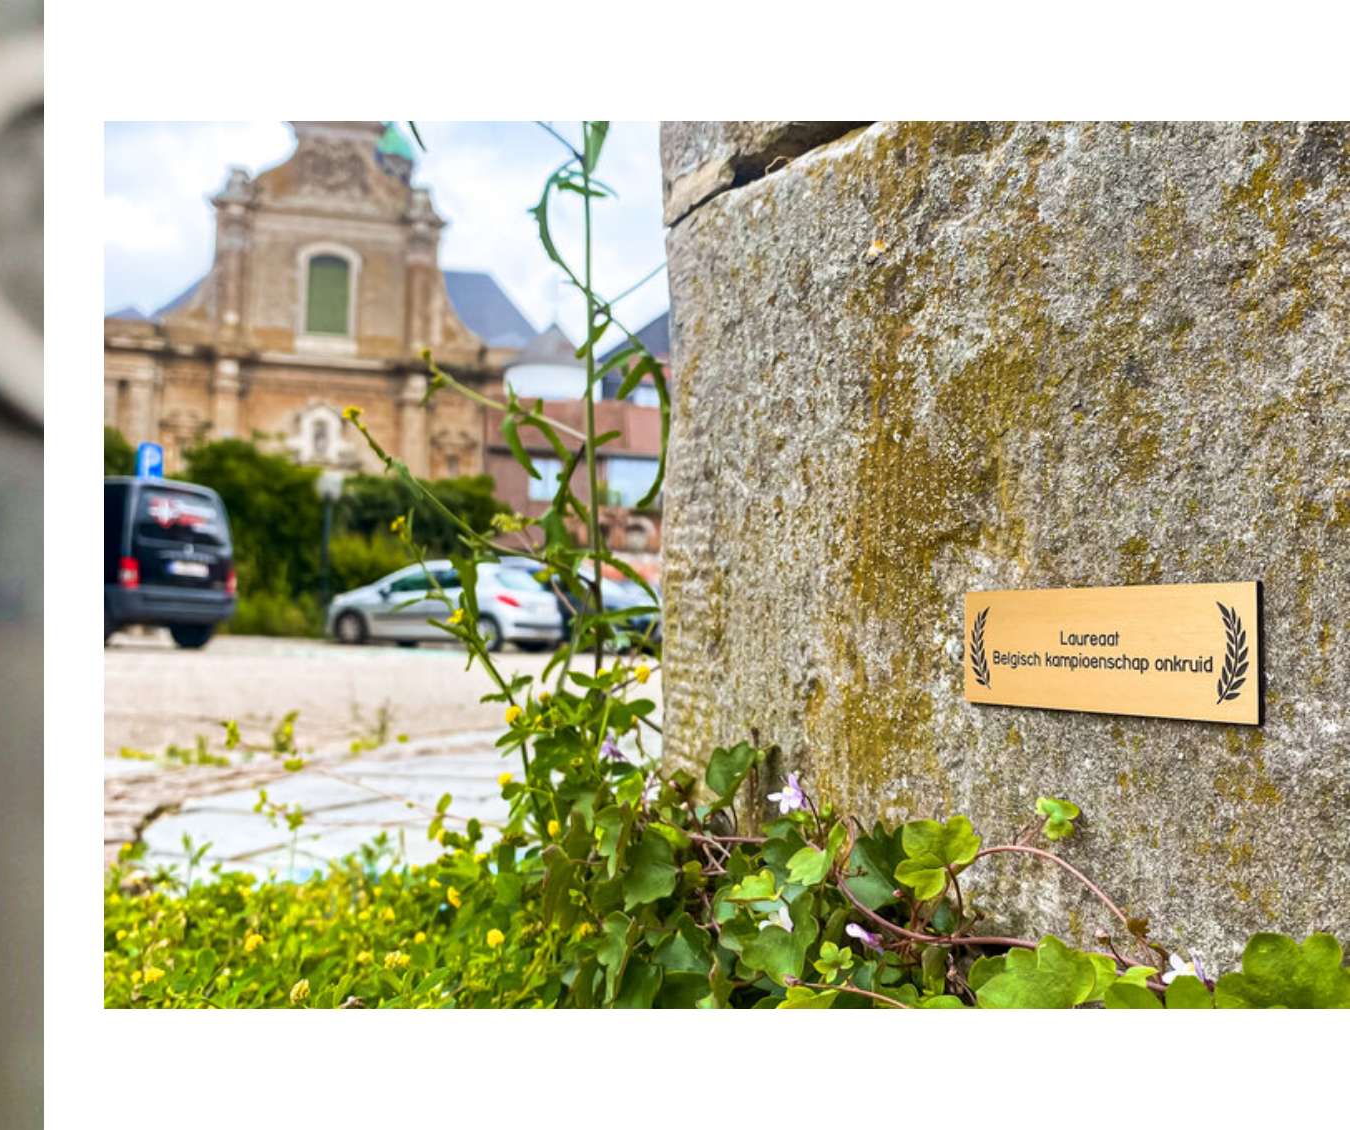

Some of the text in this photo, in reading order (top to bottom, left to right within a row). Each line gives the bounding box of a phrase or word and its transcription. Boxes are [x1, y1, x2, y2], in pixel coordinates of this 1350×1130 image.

[1058, 630, 1120, 647] Laureaat
[992, 650, 1214, 674] Belgisch kampioenschap onkruid
